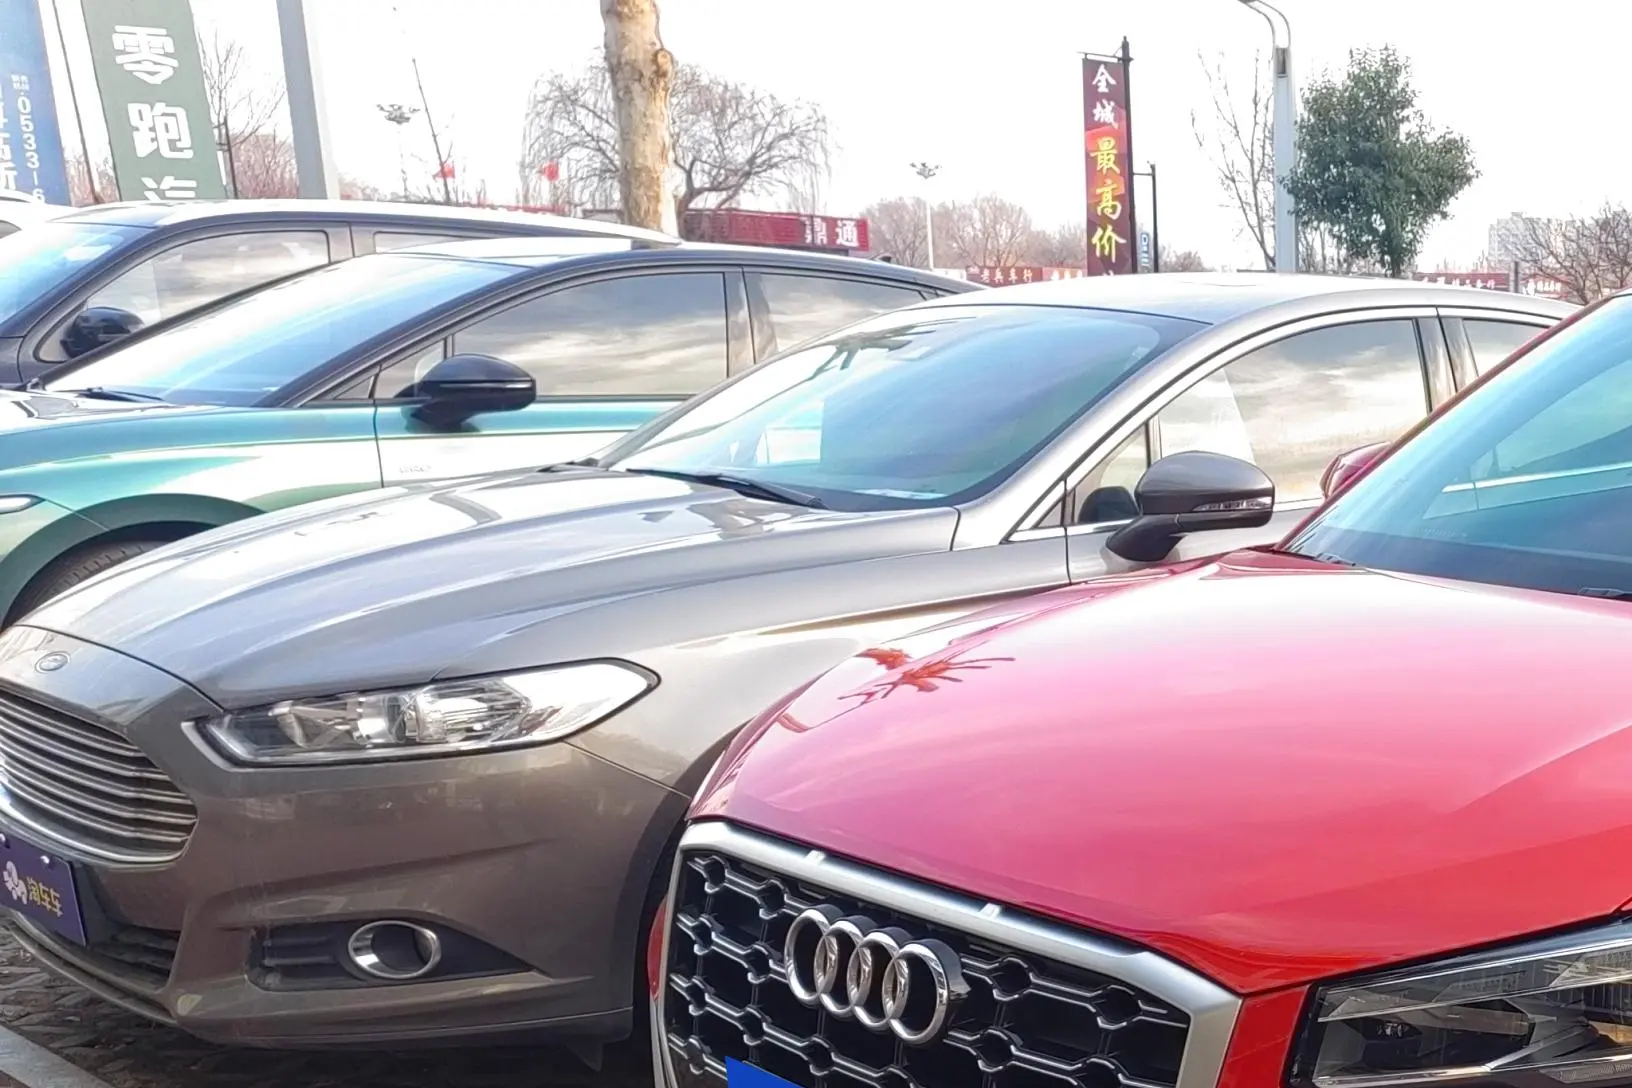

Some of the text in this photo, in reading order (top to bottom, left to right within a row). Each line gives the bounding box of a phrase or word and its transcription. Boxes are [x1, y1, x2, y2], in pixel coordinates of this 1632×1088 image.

[1091, 64, 1127, 276] 全城最高价
[26, 876, 64, 918] 淘车车
